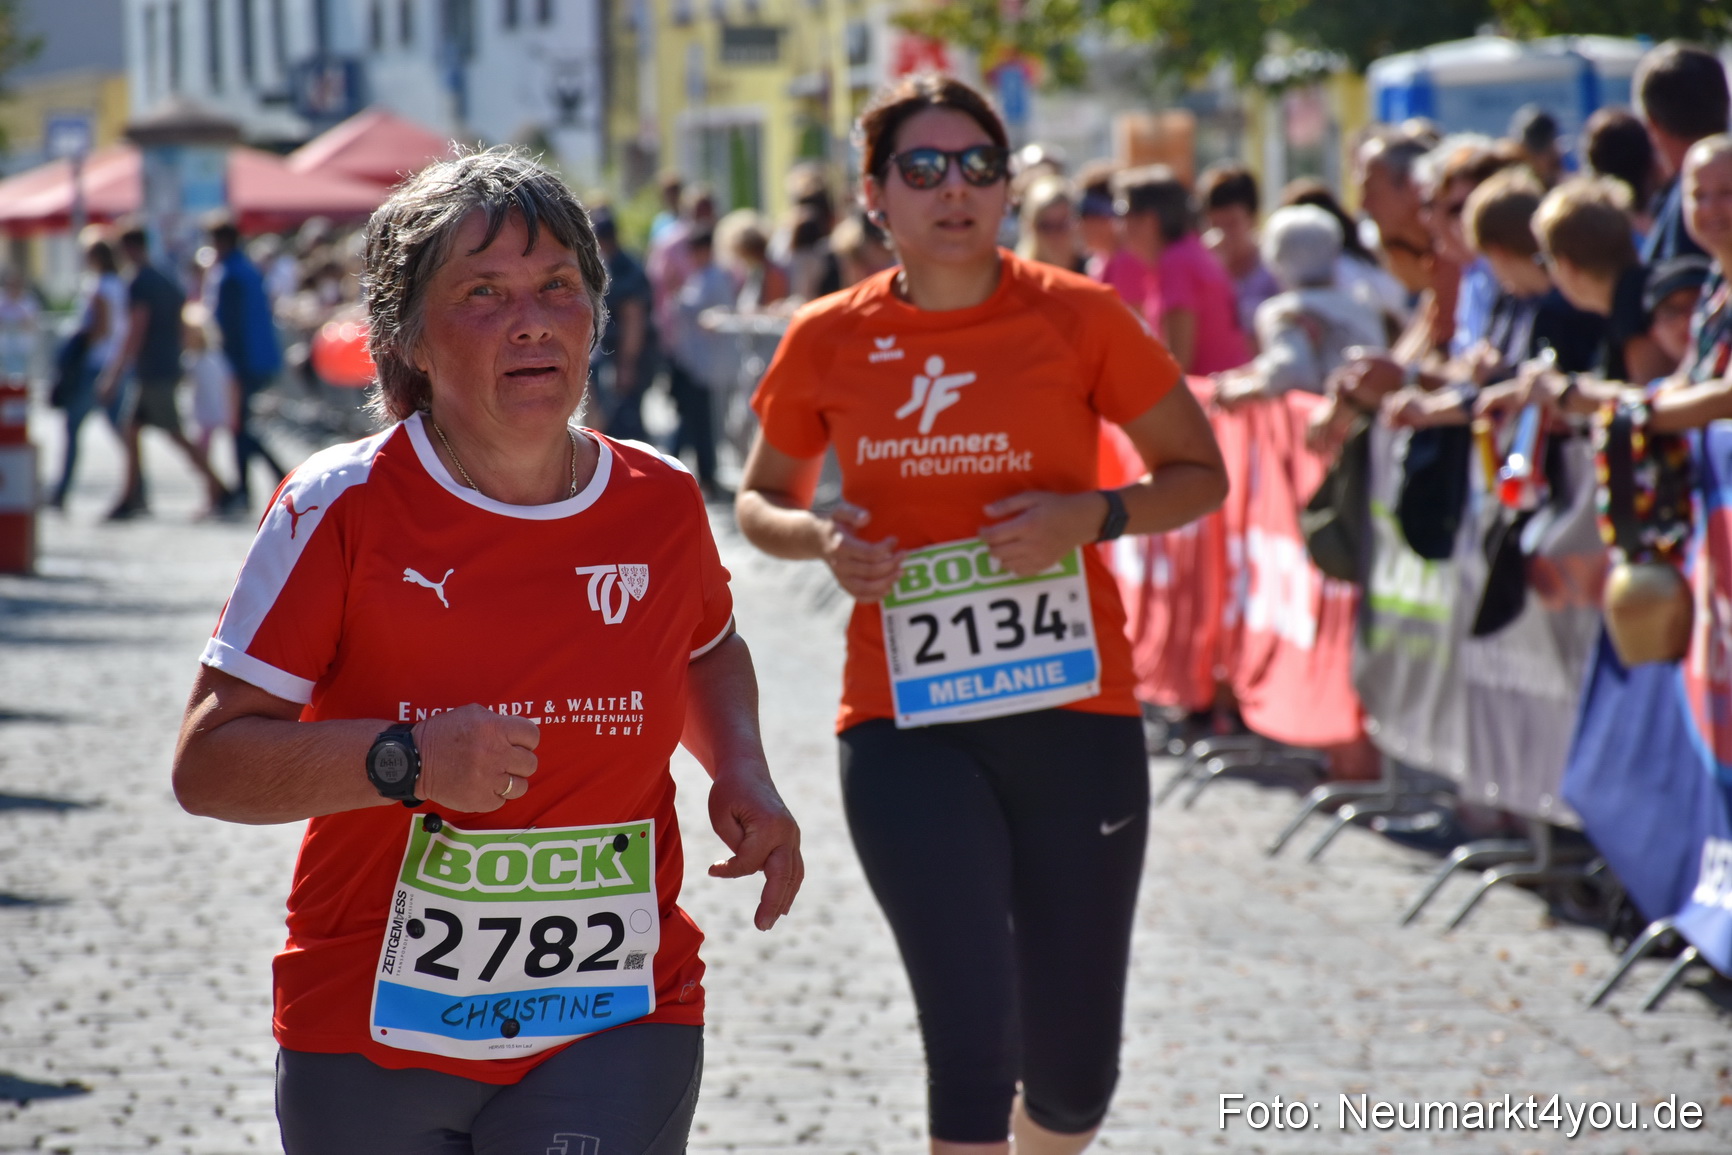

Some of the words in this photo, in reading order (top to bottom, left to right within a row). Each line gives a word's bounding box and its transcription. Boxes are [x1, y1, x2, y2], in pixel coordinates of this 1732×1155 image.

[856, 432, 1009, 465] funrunners
[901, 450, 1033, 477] neumarkt
[908, 592, 1067, 666] 2134
[927, 660, 1067, 706] MELANIE
[544, 700, 555, 713] &
[566, 690, 644, 712] WALTER
[545, 715, 566, 724] DAS
[571, 714, 644, 723] HERRENHAUS
[595, 723, 643, 736] Lauf
[416, 833, 634, 893] BOCK
[414, 907, 625, 983] 2782
[440, 992, 614, 1029] CHRISTINE
